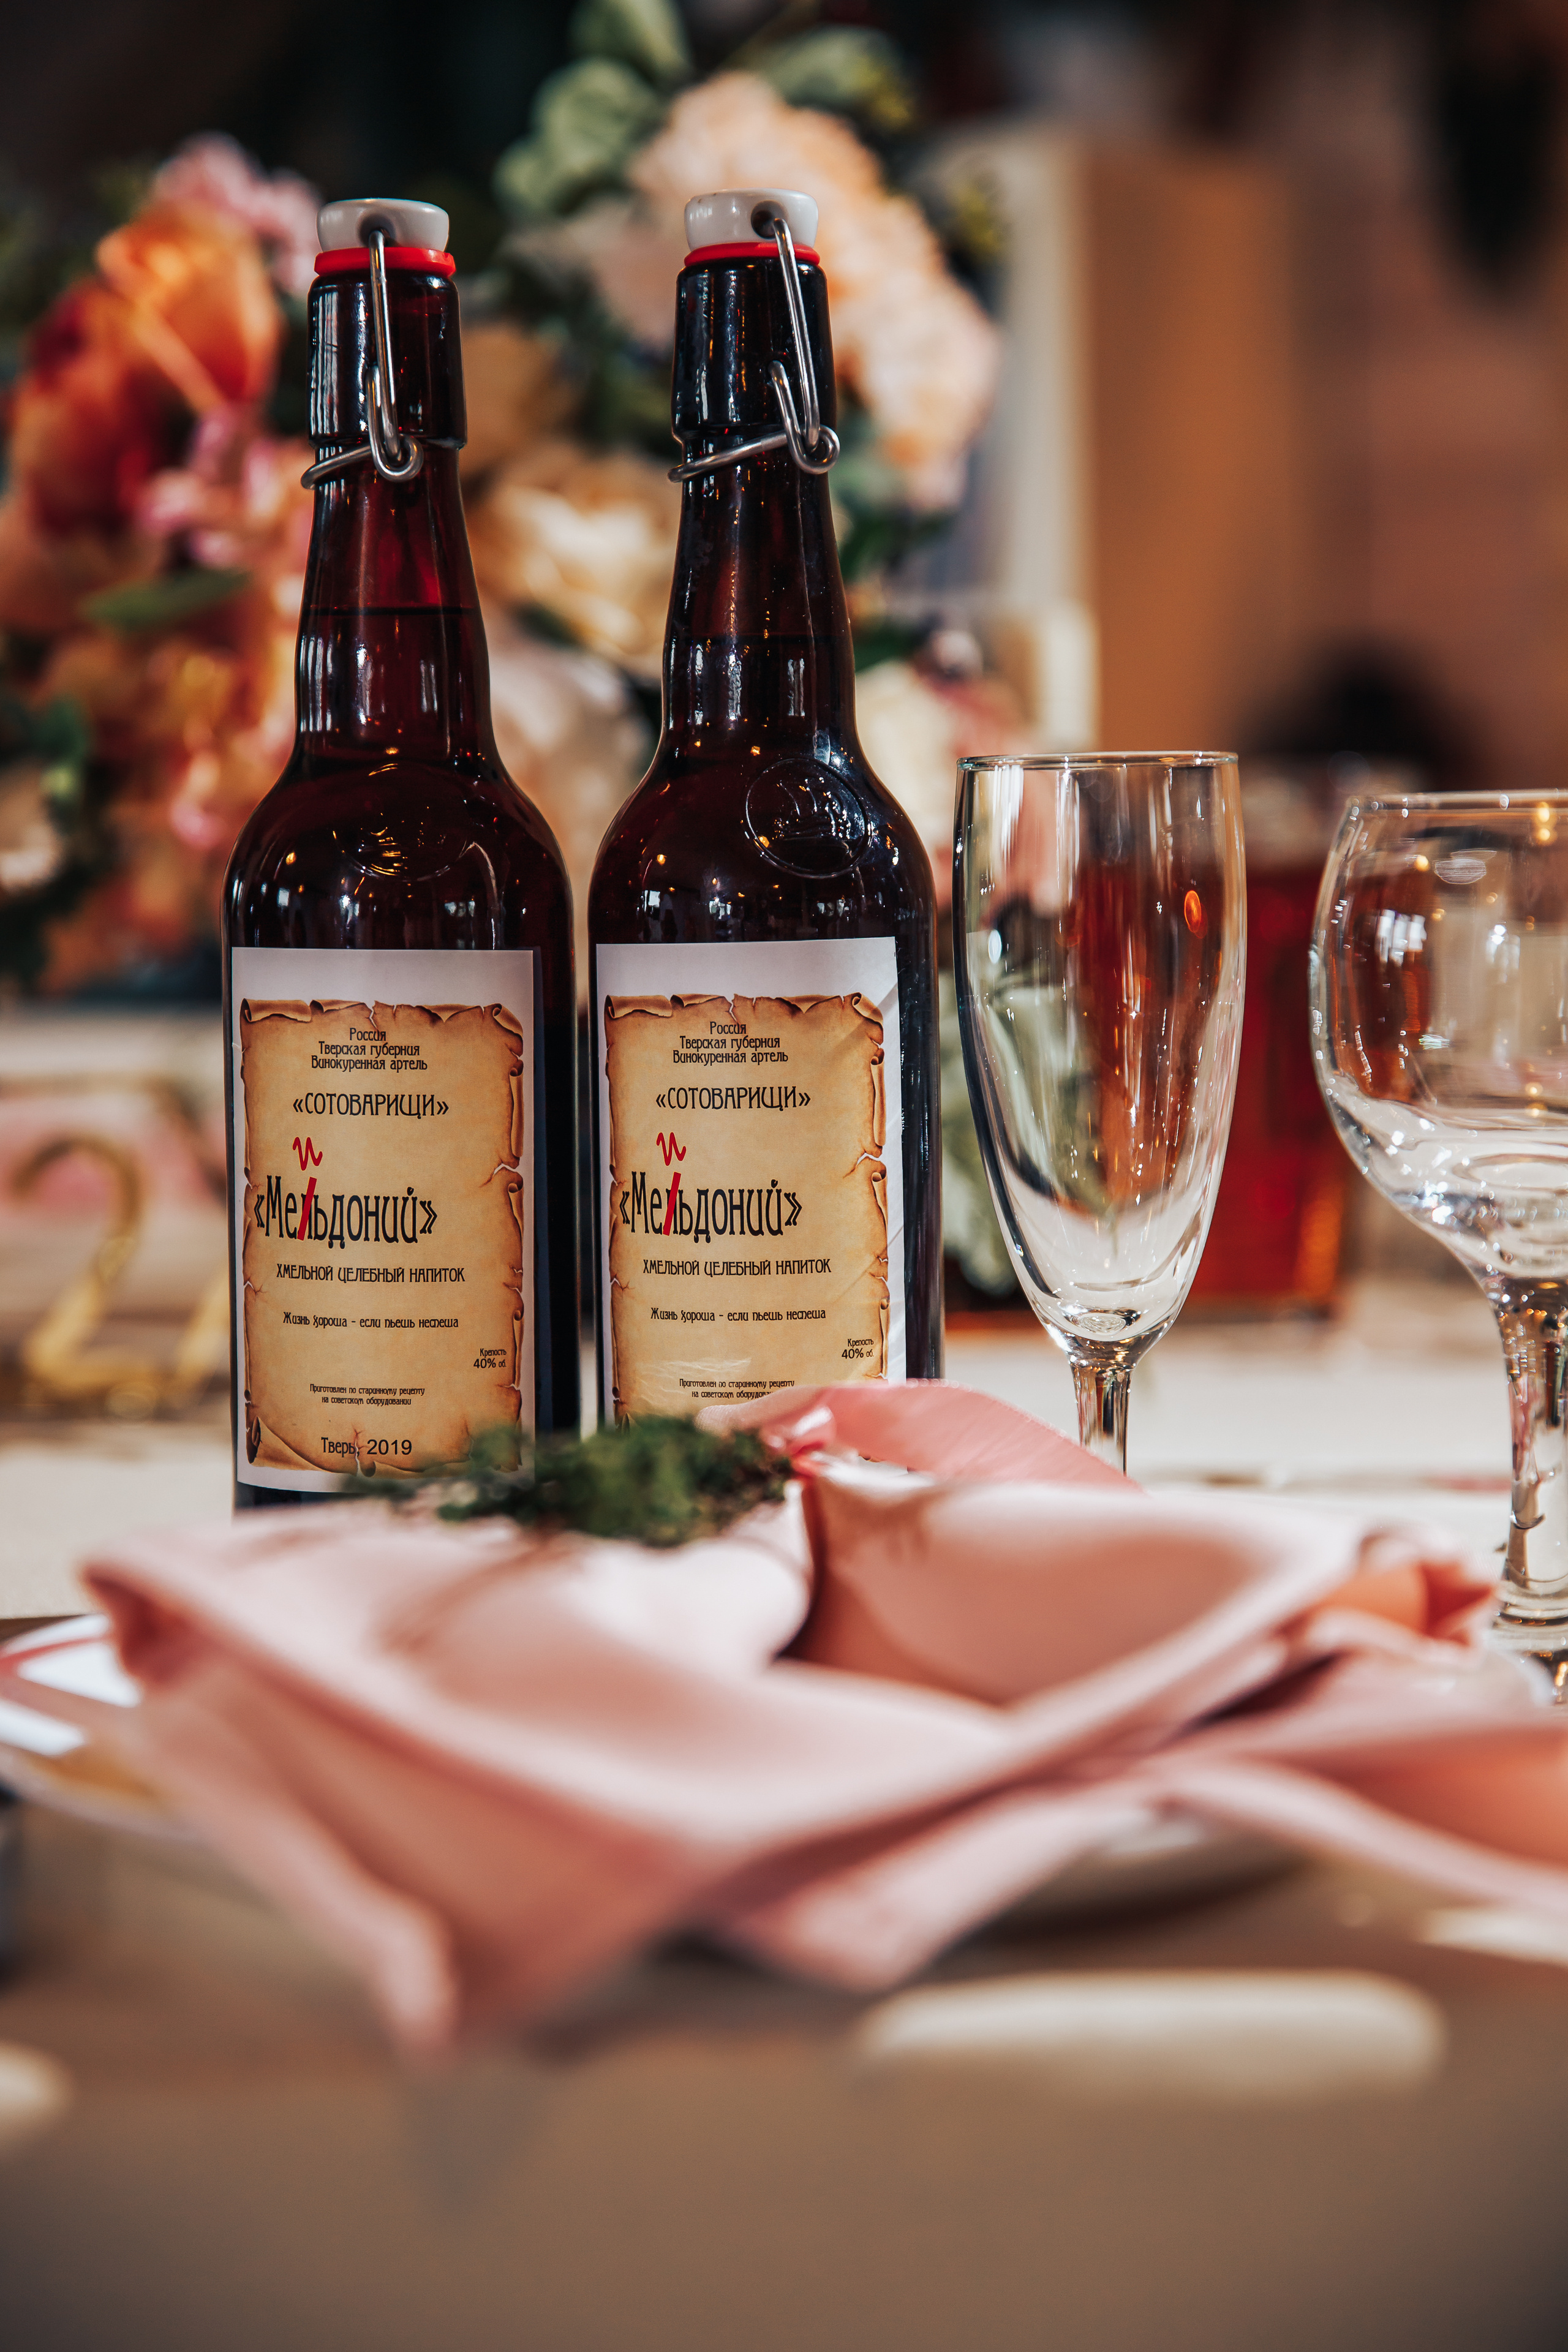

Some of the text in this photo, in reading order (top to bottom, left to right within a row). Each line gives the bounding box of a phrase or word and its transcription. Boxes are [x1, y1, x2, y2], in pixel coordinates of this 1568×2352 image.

[349, 1027, 386, 1041] Россия
[709, 1021, 747, 1035] Россия
[318, 1041, 420, 1059] Тверская губерния
[679, 1035, 780, 1052] Тверская губерния
[311, 1055, 428, 1073] Винокуренная артель
[673, 1049, 789, 1066] Винокуренная артель
[293, 1092, 449, 1120] «СОТОВАРИЩИ»
[655, 1085, 811, 1112] «СОТОВАРИЩИ»
[276, 1263, 466, 1284] ХМЕЛЬНОЙ ЦЕЛЕБНЫЙ НАПИТОК
[643, 1259, 832, 1278] ХМЕЛЬНОЙ ЦЕЛЕБНЫЙ НАПИТОК
[283, 1311, 311, 1325] Жизнь
[312, 1314, 347, 1329] хороша
[360, 1318, 381, 1328] если
[384, 1319, 415, 1329] пьешь
[418, 1318, 459, 1328] неспеша
[650, 1307, 678, 1321] Жизнь
[680, 1310, 715, 1324] хороша
[727, 1312, 749, 1321] если
[752, 1311, 783, 1321] пьешь
[786, 1310, 826, 1321] неспеша
[847, 1338, 874, 1348] Крепость
[480, 1348, 507, 1358] Крепость
[841, 1348, 864, 1360] 40%
[473, 1358, 497, 1369] 40%
[310, 1383, 347, 1394] Приготовлен
[358, 1387, 398, 1396] старинному
[399, 1388, 425, 1396] рецепту
[679, 1378, 717, 1389] Приготовлен
[728, 1381, 767, 1390] старинному
[331, 1396, 364, 1406] советском
[366, 1396, 412, 1407] оборудовании
[321, 1436, 412, 1458] Тверь, 2019
